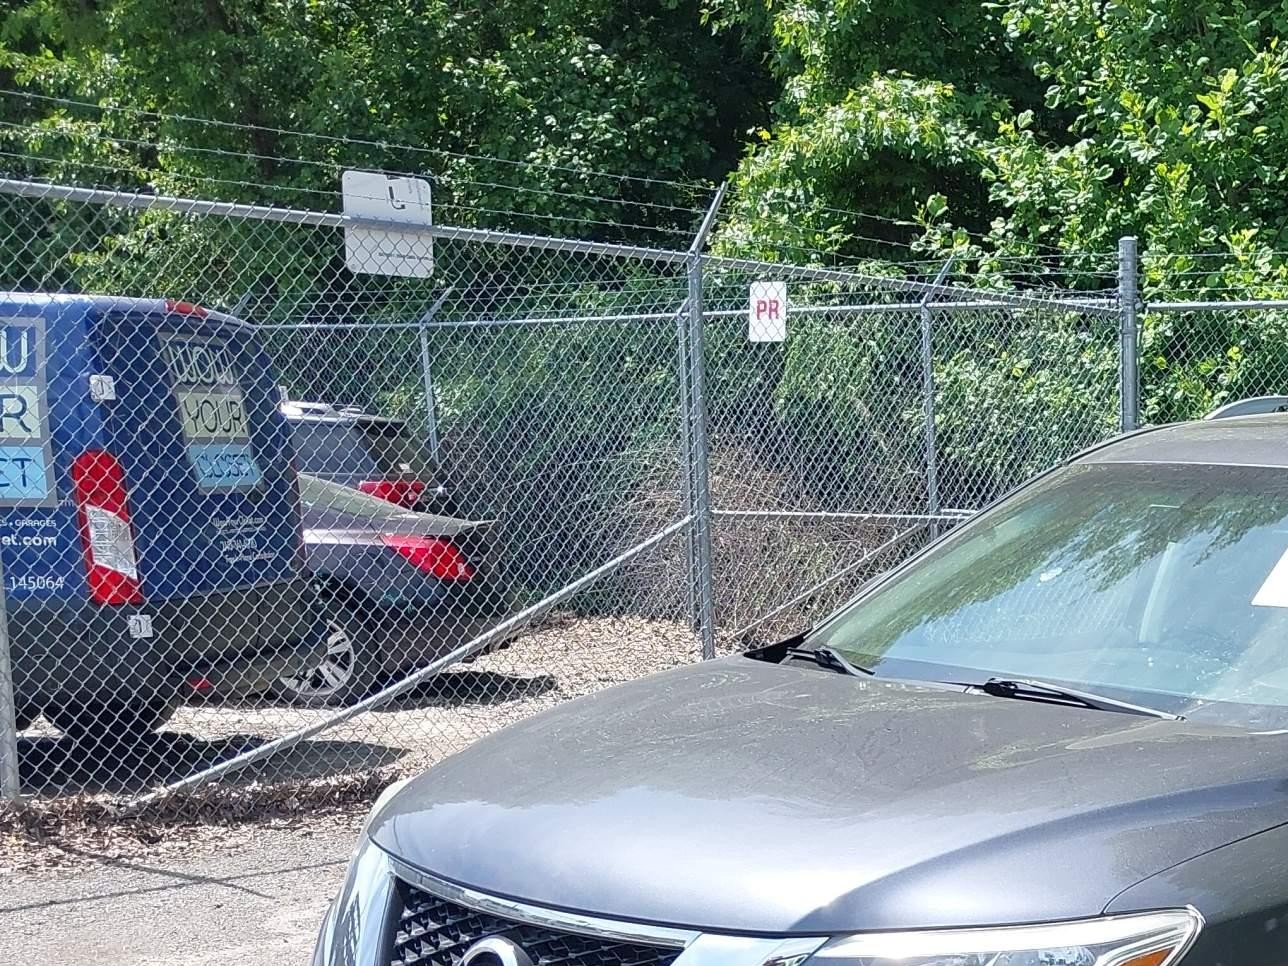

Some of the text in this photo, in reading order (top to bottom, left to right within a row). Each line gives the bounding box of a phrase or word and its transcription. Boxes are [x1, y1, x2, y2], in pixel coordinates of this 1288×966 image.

[756, 299, 779, 320] PR
[184, 399, 246, 433] YOUR
[15, 519, 57, 527] GARAGES
[10, 576, 65, 590] 145064
